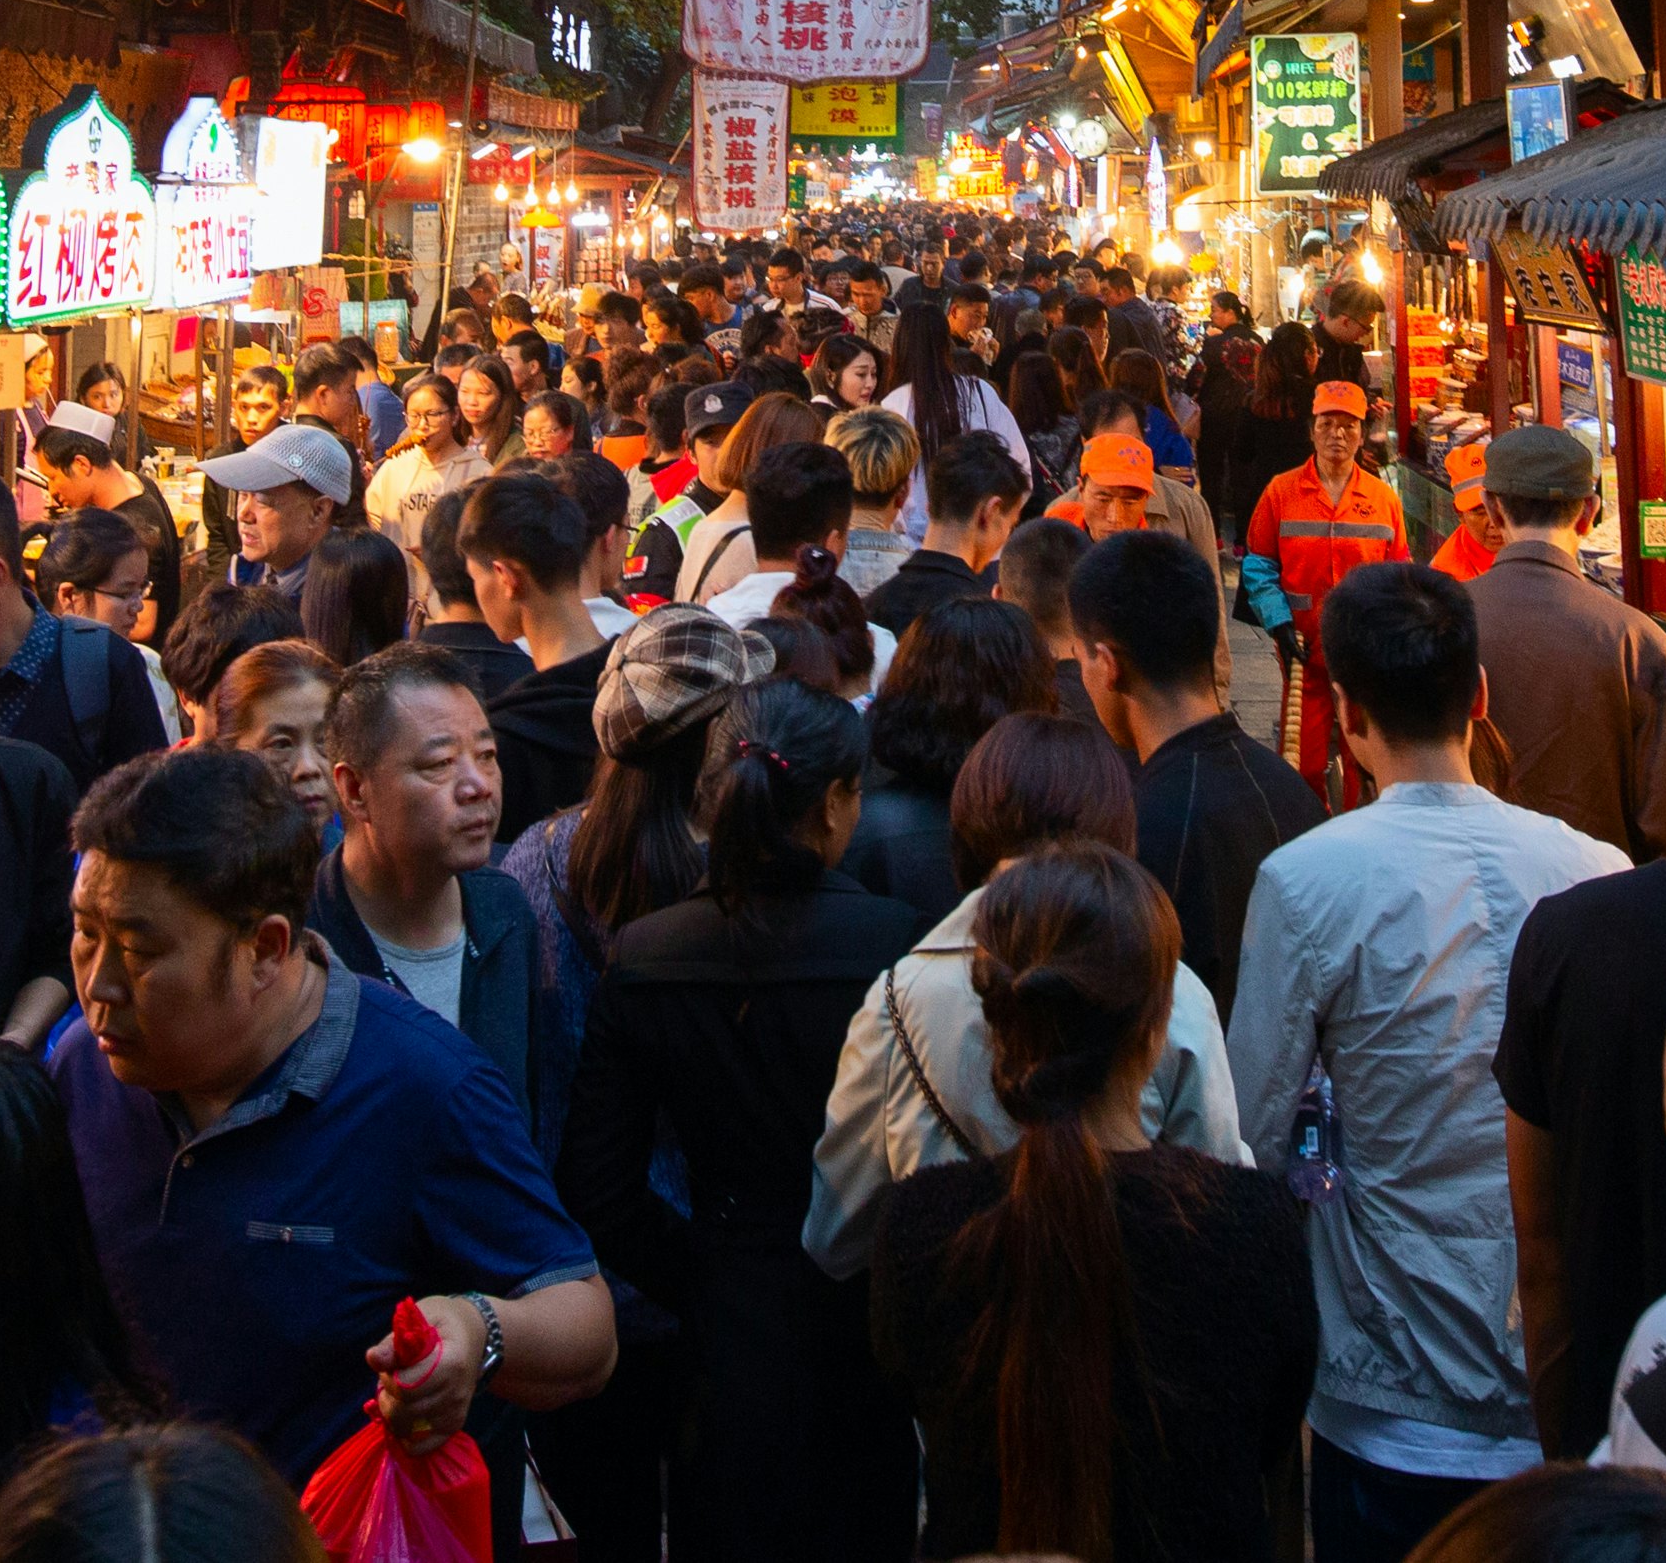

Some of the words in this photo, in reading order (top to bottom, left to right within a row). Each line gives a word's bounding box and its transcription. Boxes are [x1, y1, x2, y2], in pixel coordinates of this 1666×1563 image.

[724, 116, 757, 209] 椒盐核桃
[16, 206, 146, 308] 红柳烤肉
